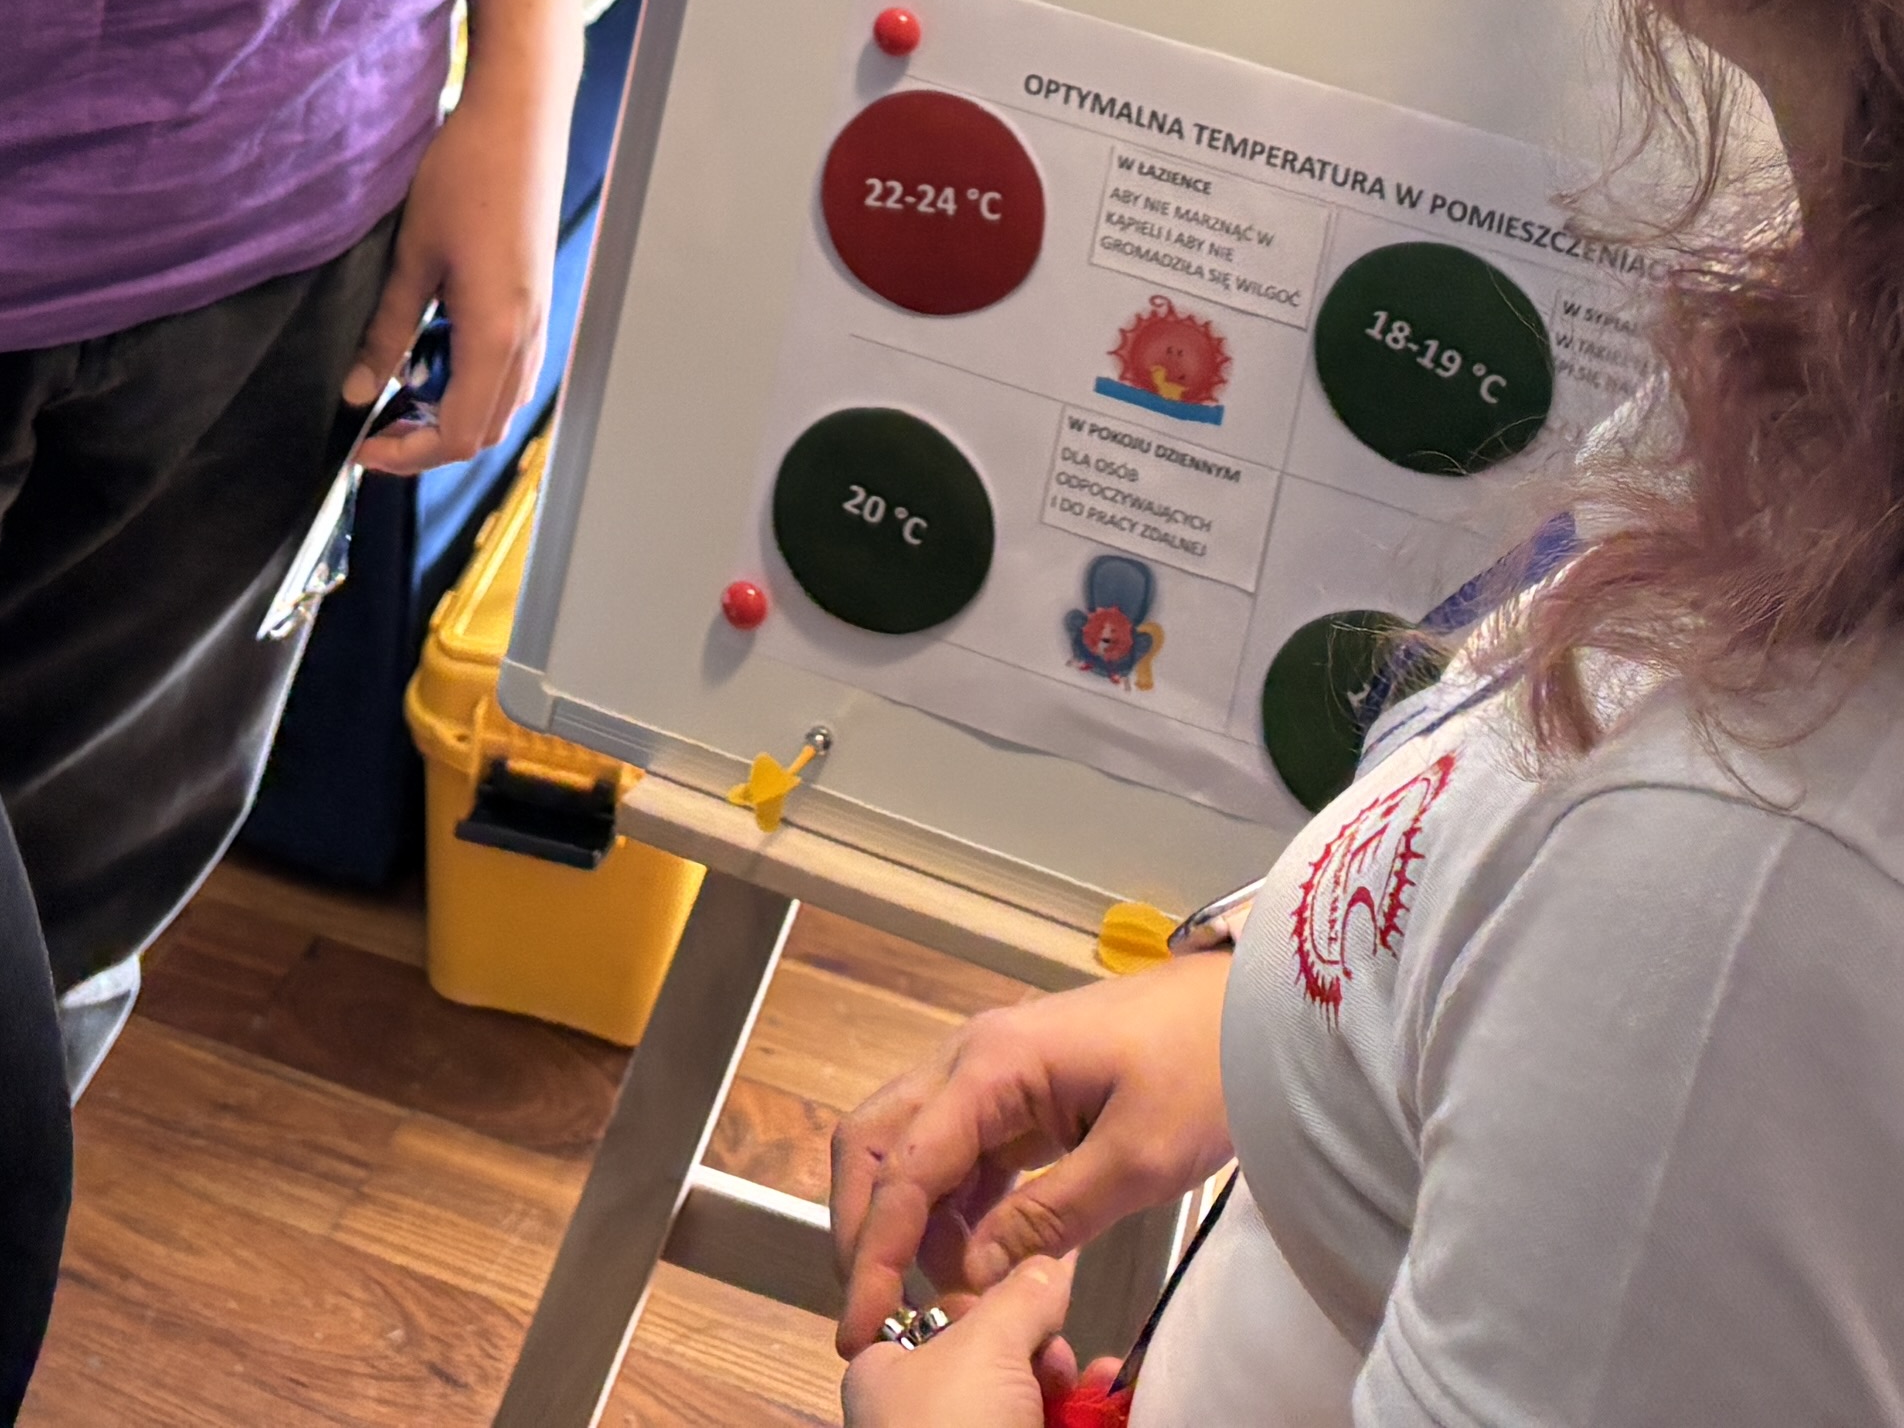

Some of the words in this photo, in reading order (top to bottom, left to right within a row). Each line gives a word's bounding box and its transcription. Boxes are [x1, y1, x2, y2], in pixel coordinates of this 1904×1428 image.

[1023, 73, 1185, 141] OPTYMALNA
[1192, 123, 1386, 201] TEMPERATURA
[1395, 183, 1425, 210] W
[1429, 193, 1670, 284] POMIESZCZENIAC
[1116, 154, 1136, 172] W
[1137, 160, 1213, 196] ŁAZIENCE
[864, 177, 958, 216] 22-24
[966, 187, 1003, 221] °C
[1109, 186, 1143, 205] ABY
[1143, 197, 1171, 216] NIE
[1174, 205, 1255, 243] MARZNĄĆ
[1256, 230, 1275, 247] W
[1174, 232, 1206, 251] ABY
[1208, 242, 1235, 263] NIE
[1364, 310, 1463, 379] 18-19
[1472, 362, 1508, 405] °C
[1066, 415, 1087, 433] W
[1060, 446, 1092, 469] DLA
[841, 484, 887, 524] 20
[893, 506, 929, 546] °C
[1058, 497, 1085, 517] DO
[1086, 507, 1140, 534] PRACY
